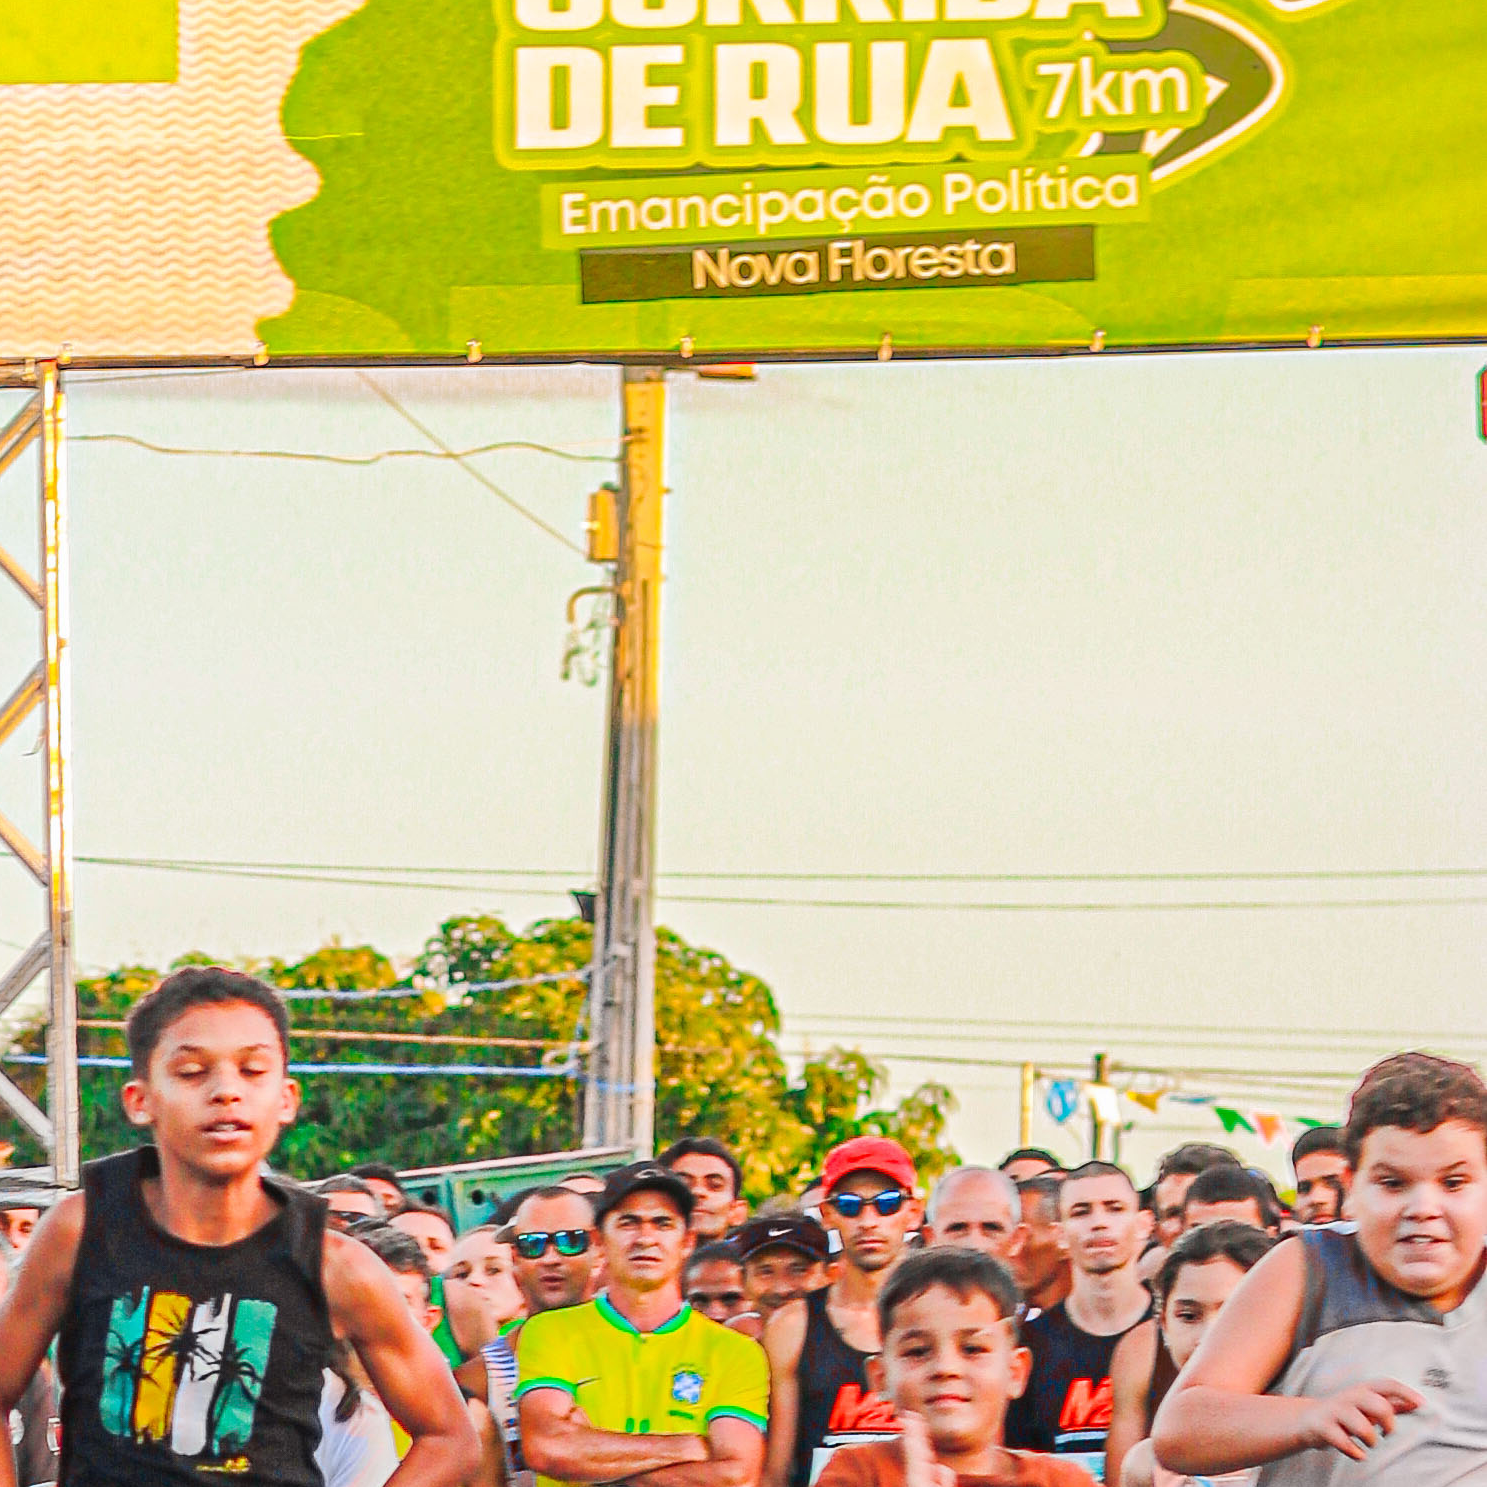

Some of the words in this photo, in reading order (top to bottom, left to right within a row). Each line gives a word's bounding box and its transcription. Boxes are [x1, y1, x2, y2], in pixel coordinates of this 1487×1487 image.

[513, 41, 686, 151] DE
[714, 38, 1018, 148] RUA
[1034, 61, 1190, 122] 7km
[559, 174, 931, 238] Emancipação
[943, 162, 1139, 216] Política
[691, 247, 820, 292] Nova
[829, 237, 1017, 285] Floresta
